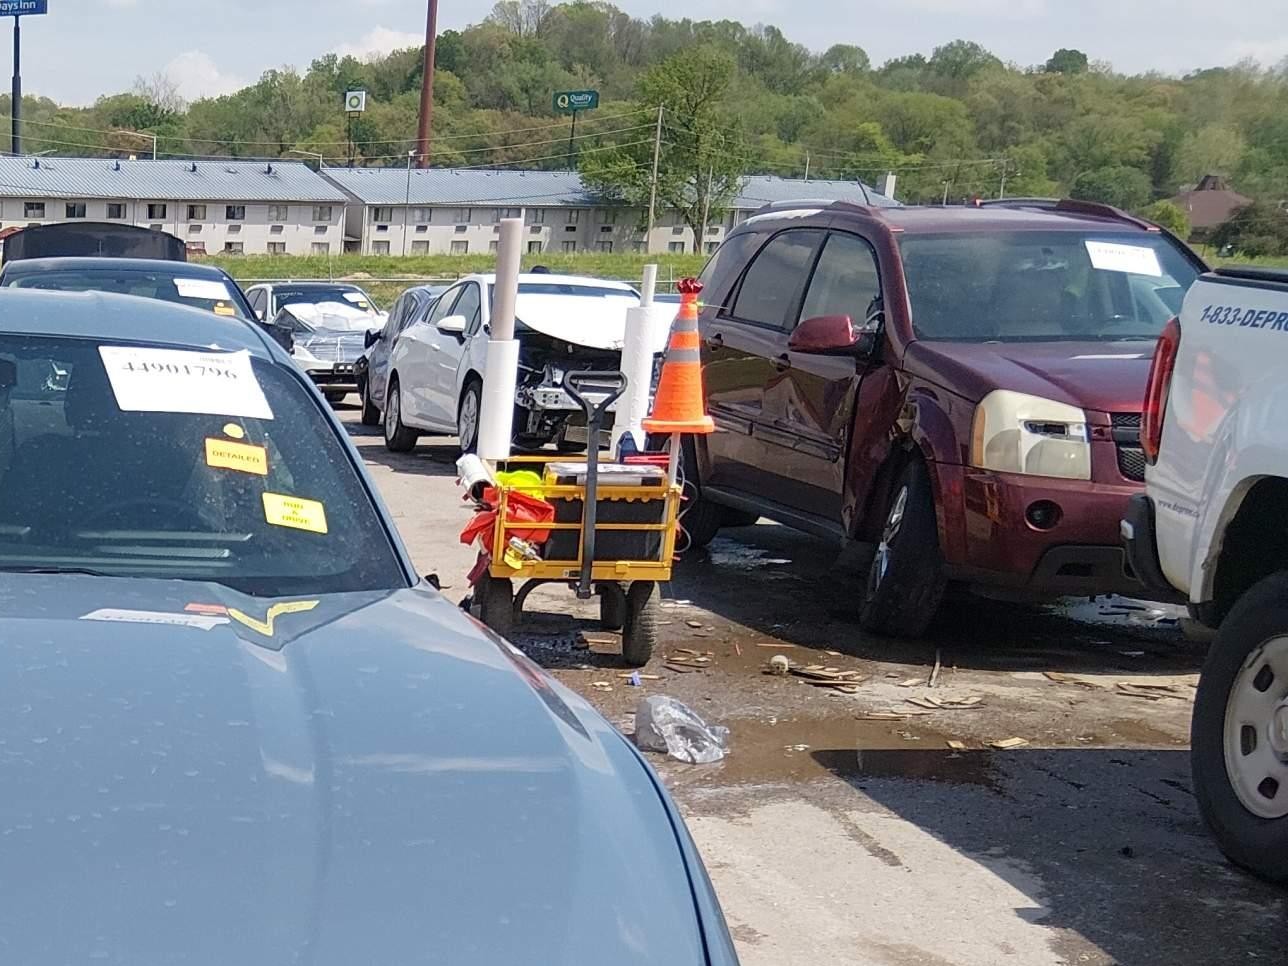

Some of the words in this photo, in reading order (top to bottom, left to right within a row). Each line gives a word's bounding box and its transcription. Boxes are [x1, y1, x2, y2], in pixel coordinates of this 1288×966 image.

[19, 0, 36, 9] Inn
[122, 361, 238, 379] 44901796
[212, 450, 261, 464] DETAILED
